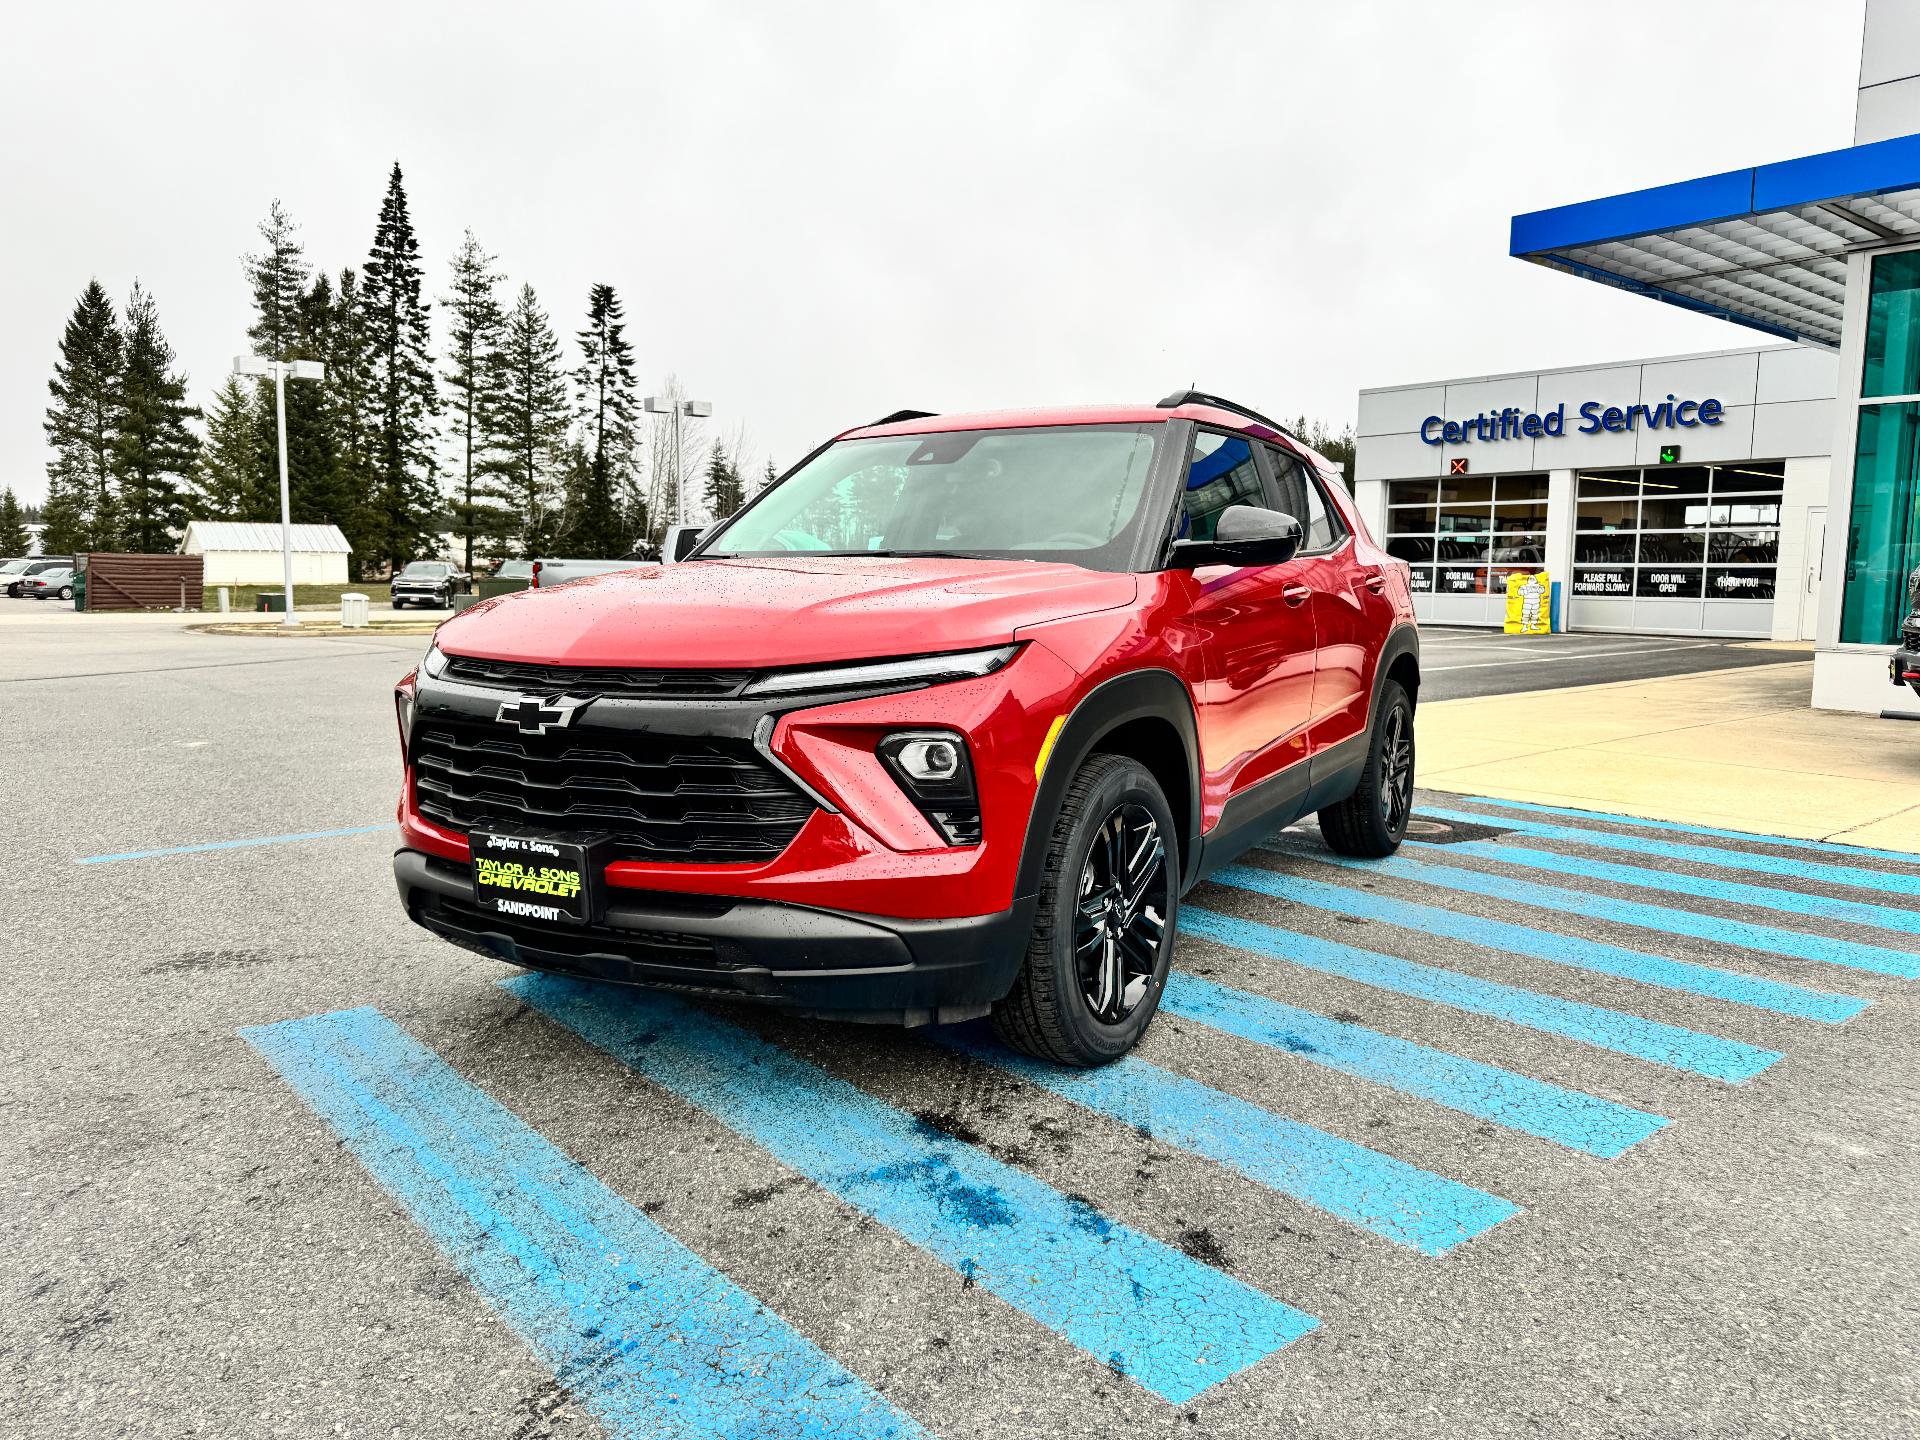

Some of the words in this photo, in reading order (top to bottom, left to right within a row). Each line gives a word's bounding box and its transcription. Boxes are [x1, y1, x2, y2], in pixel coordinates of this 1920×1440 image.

[1420, 402, 1565, 445] Certified
[1578, 393, 1723, 433] Service
[1412, 572, 1424, 580] PULL
[1446, 572, 1461, 580] DOOR
[1462, 572, 1474, 580] WILL
[1583, 573, 1606, 583] PLEASE
[1606, 573, 1622, 583] PULL
[1650, 573, 1669, 583] DOOR
[1670, 574, 1687, 583] WILL
[1452, 581, 1467, 589] OPEN
[1716, 576, 1740, 587] THANK
[1741, 577, 1759, 587] YOU!
[1574, 582, 1604, 592] FORWARD
[1604, 583, 1630, 592] SLOWLY
[1659, 583, 1677, 593] OPEN
[490, 836, 519, 850] Taylor
[530, 841, 554, 854] Sons
[475, 857, 524, 875] TAYLOR
[528, 866, 536, 878] &
[540, 868, 580, 884] SONS
[478, 872, 581, 898] CHEVROLET
[497, 899, 560, 920] SANDPOINT
